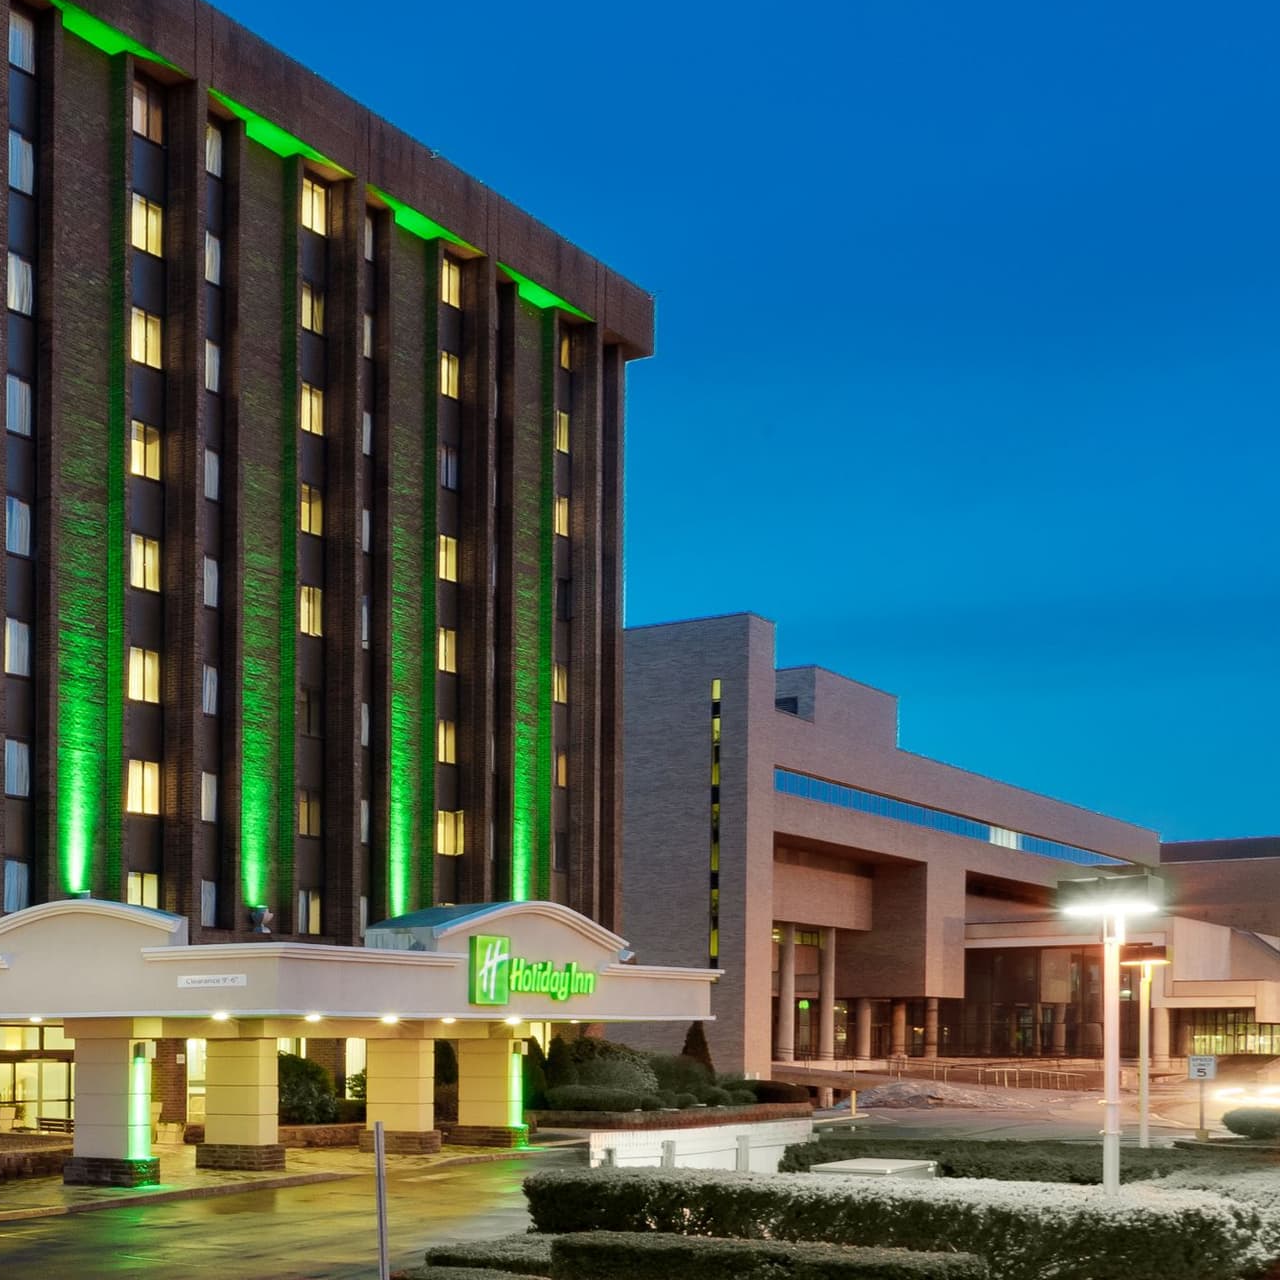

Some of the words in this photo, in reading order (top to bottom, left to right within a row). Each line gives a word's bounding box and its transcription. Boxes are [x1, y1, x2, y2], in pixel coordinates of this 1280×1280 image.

[509, 958, 570, 1001] Holiday
[569, 961, 595, 994] Inn
[1197, 1068, 1207, 1077] 5
